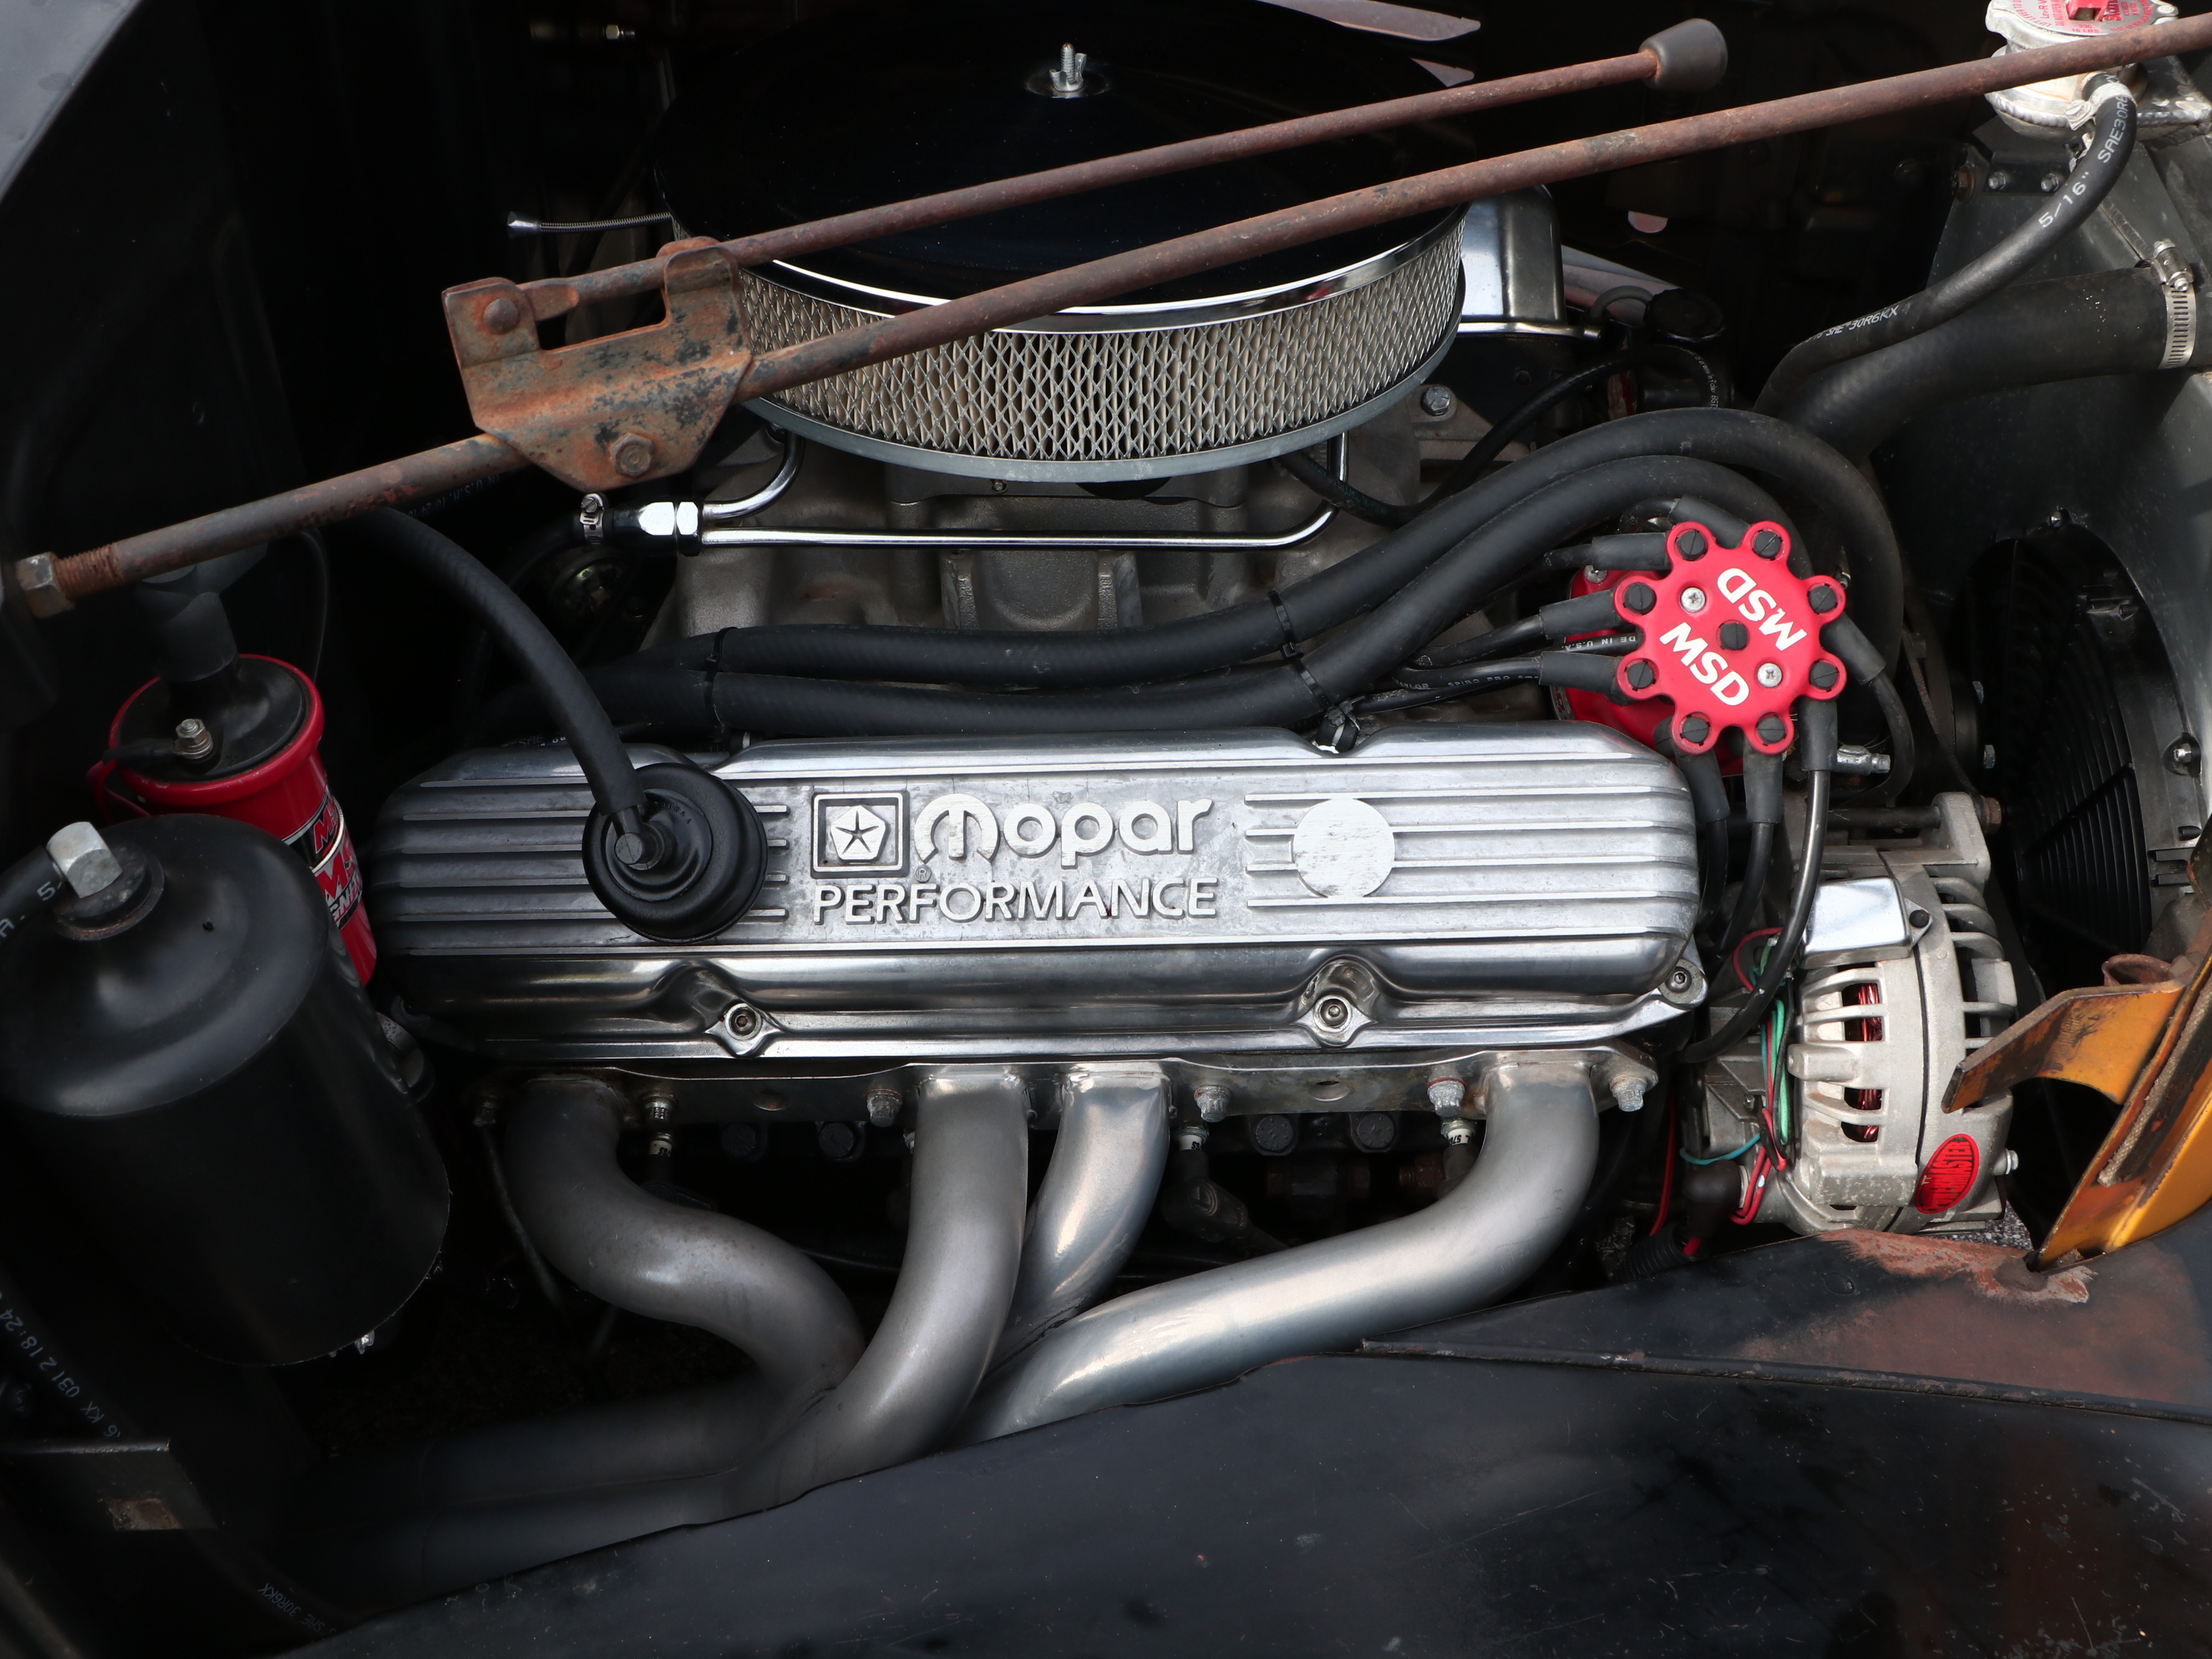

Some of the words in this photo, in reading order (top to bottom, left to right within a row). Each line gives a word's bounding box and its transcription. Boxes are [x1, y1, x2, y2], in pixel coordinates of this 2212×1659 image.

[1717, 567, 1808, 651] MSD
[1659, 622, 1750, 706] MSD
[813, 877, 1218, 925] PERFORMANCE
